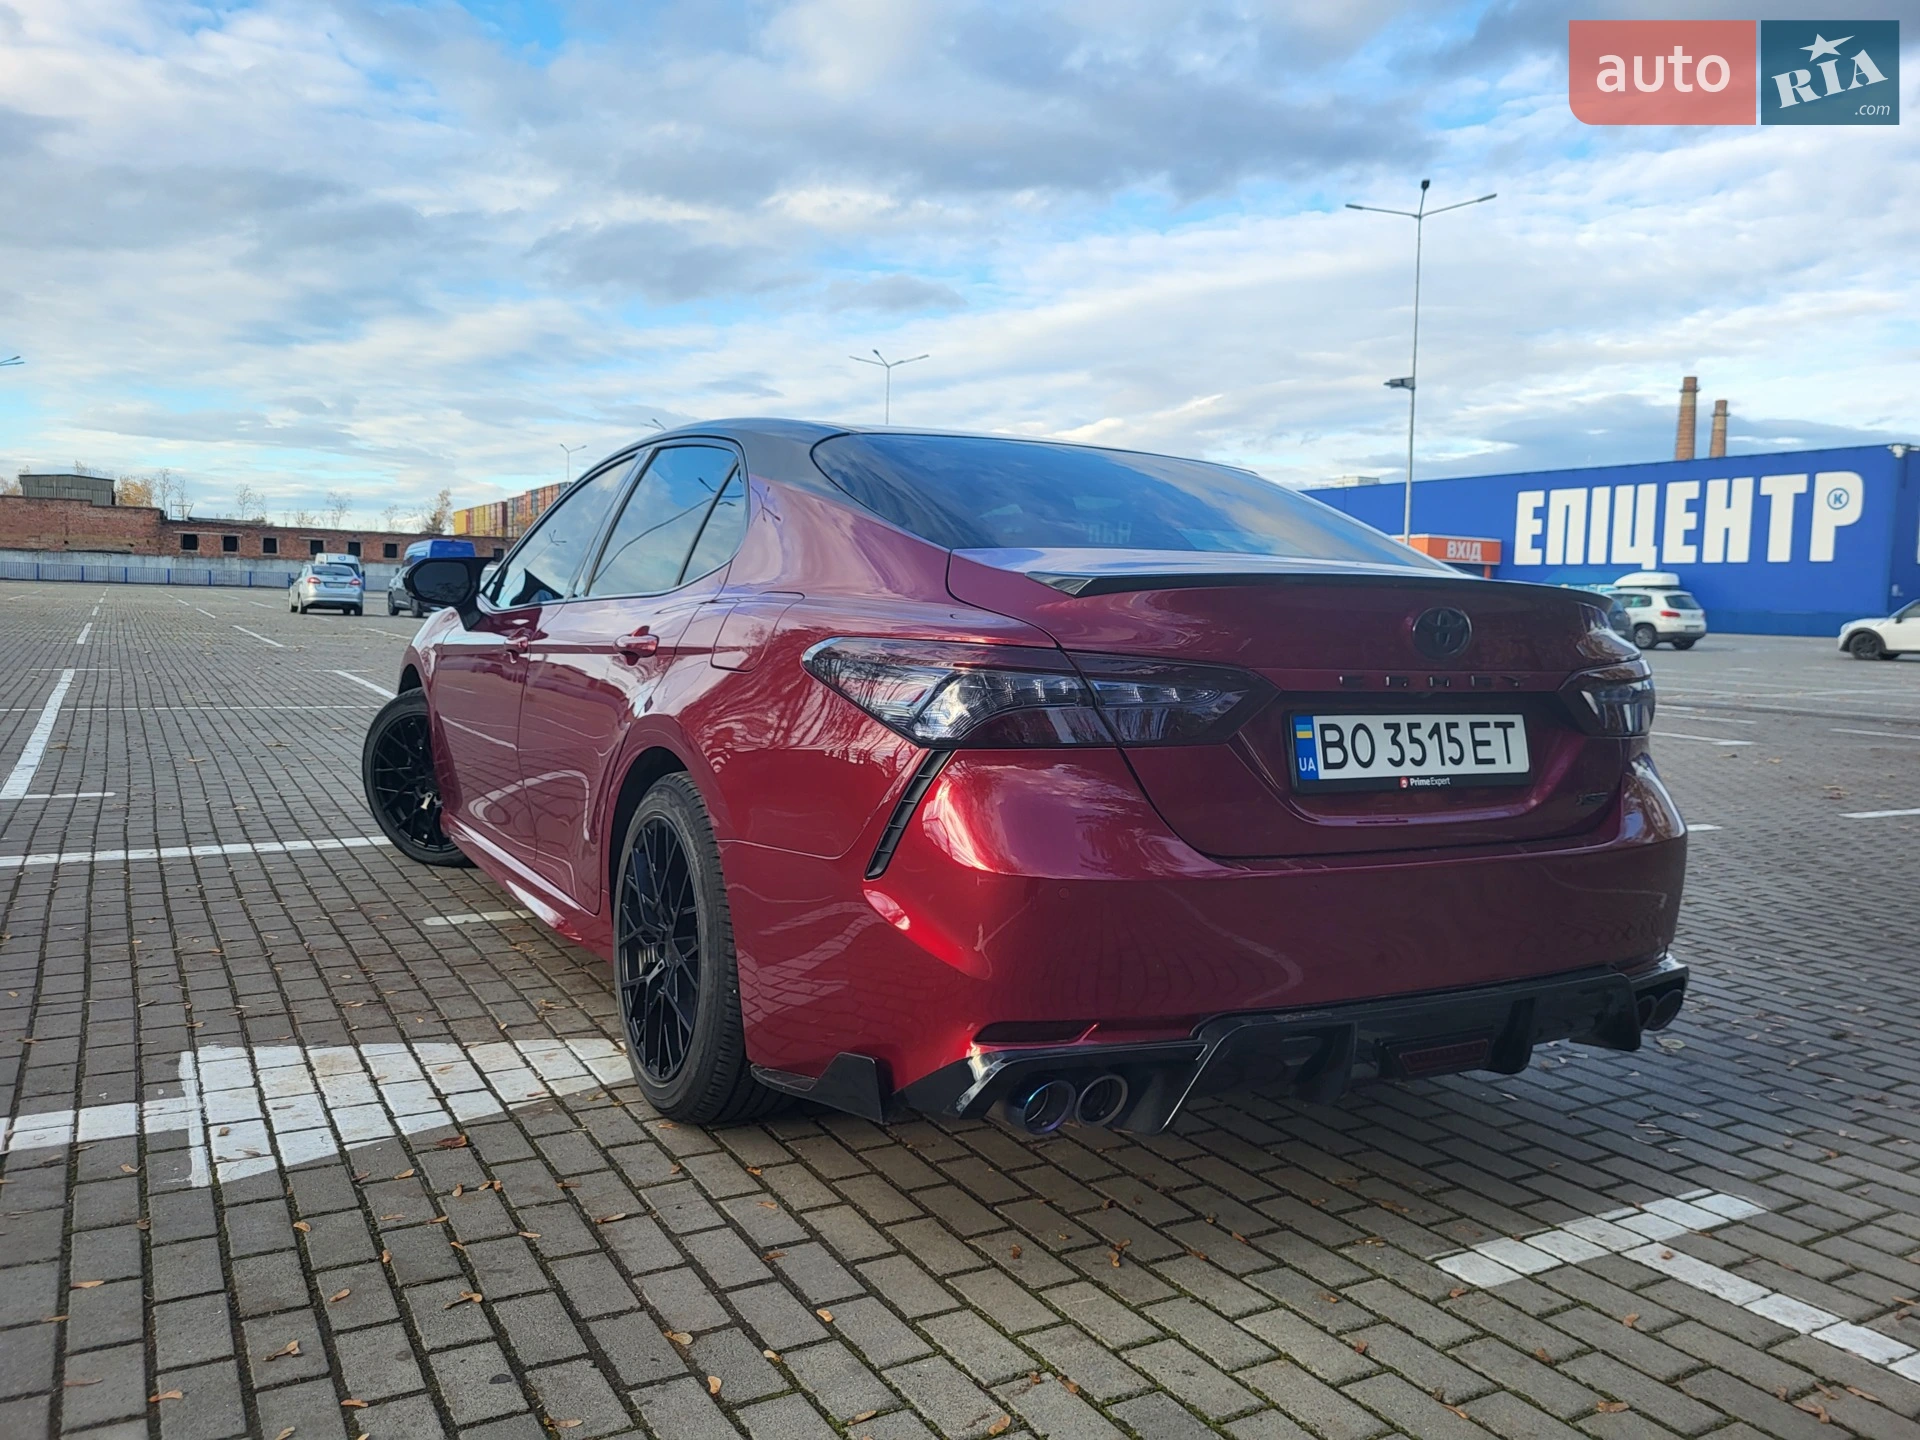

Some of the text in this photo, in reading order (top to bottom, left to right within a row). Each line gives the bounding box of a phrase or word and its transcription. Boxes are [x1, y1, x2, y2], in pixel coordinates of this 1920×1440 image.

[1514, 471, 1864, 570] ЕПІЦЕНТР
[1446, 541, 1482, 562] ВХІД
[1298, 757, 1316, 772] UA
